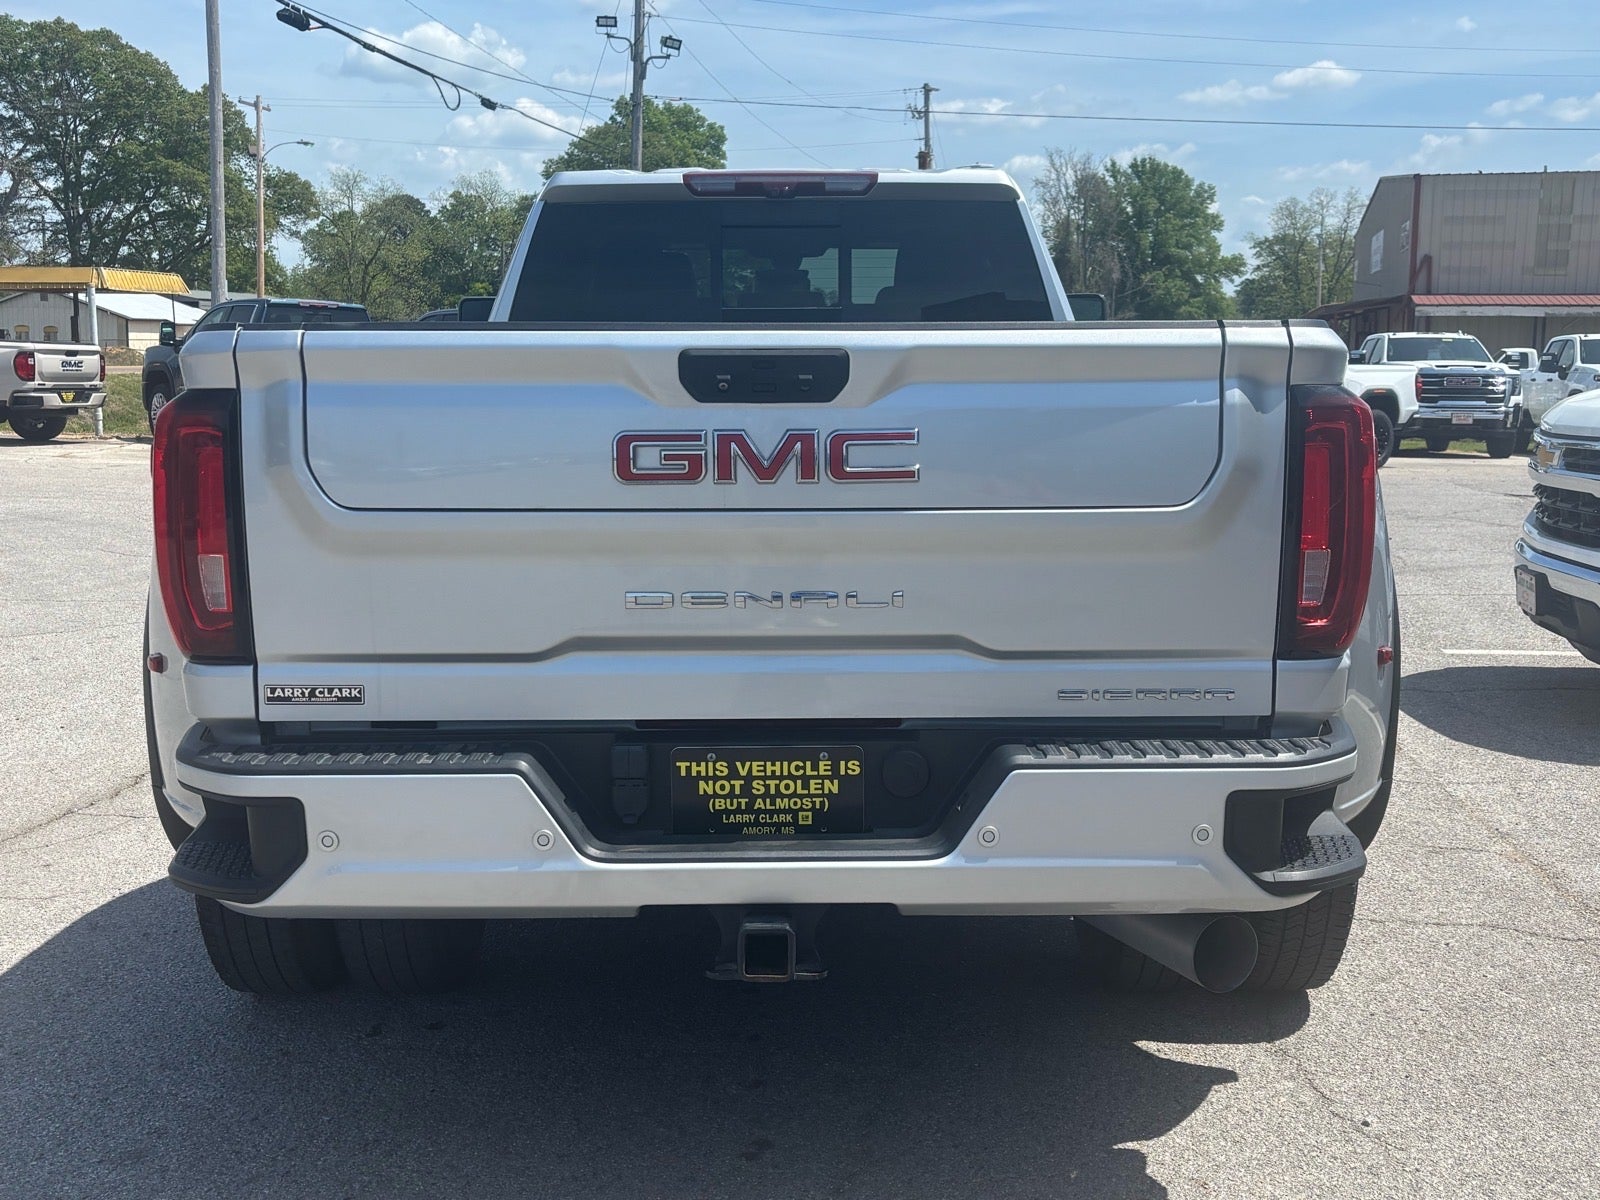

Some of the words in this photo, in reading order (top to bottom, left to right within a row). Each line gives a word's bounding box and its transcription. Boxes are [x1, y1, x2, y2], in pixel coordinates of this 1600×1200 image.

[612, 428, 920, 485] GMC
[624, 590, 904, 610] DENALI
[267, 688, 311, 697] LARRY
[315, 688, 361, 697] CLARK
[1057, 688, 1236, 701] SIERRA
[676, 761, 729, 777] THIS
[735, 760, 832, 776] VEHICLE
[839, 760, 861, 775] IS
[699, 780, 745, 795] NOT
[751, 779, 839, 795] STOLEN
[708, 798, 749, 812] (BUT
[754, 797, 829, 812] ALMOST)
[722, 814, 756, 823] LARRY
[759, 813, 793, 823] CLARK
[781, 826, 795, 835] MS
